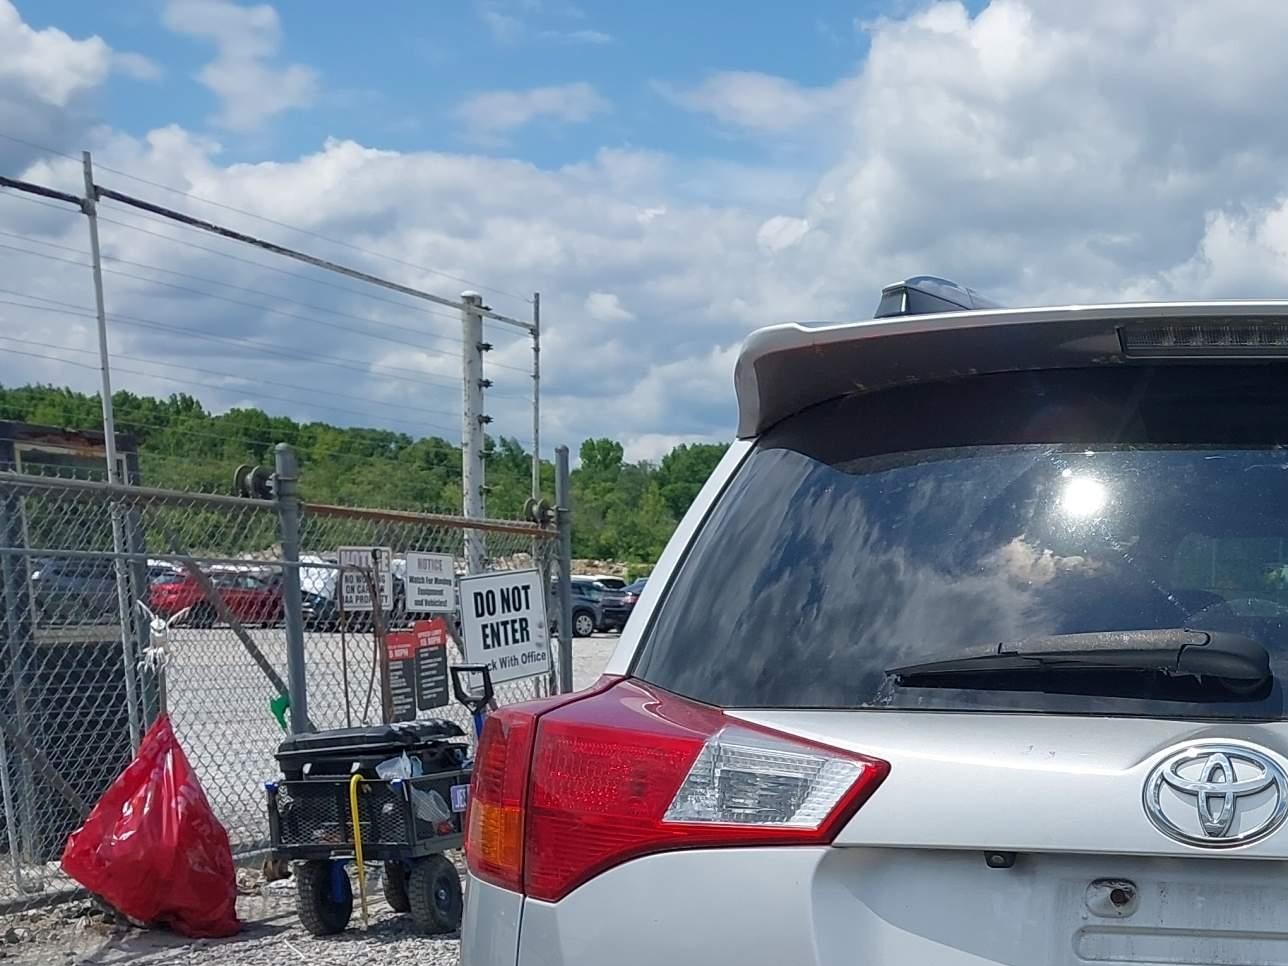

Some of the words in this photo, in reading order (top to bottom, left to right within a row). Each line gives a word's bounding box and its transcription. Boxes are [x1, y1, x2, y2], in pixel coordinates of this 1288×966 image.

[473, 589, 497, 618] DO
[500, 584, 531, 614] NOT
[481, 617, 531, 650] ENTER
[499, 654, 520, 670] With
[521, 651, 546, 665] Office
